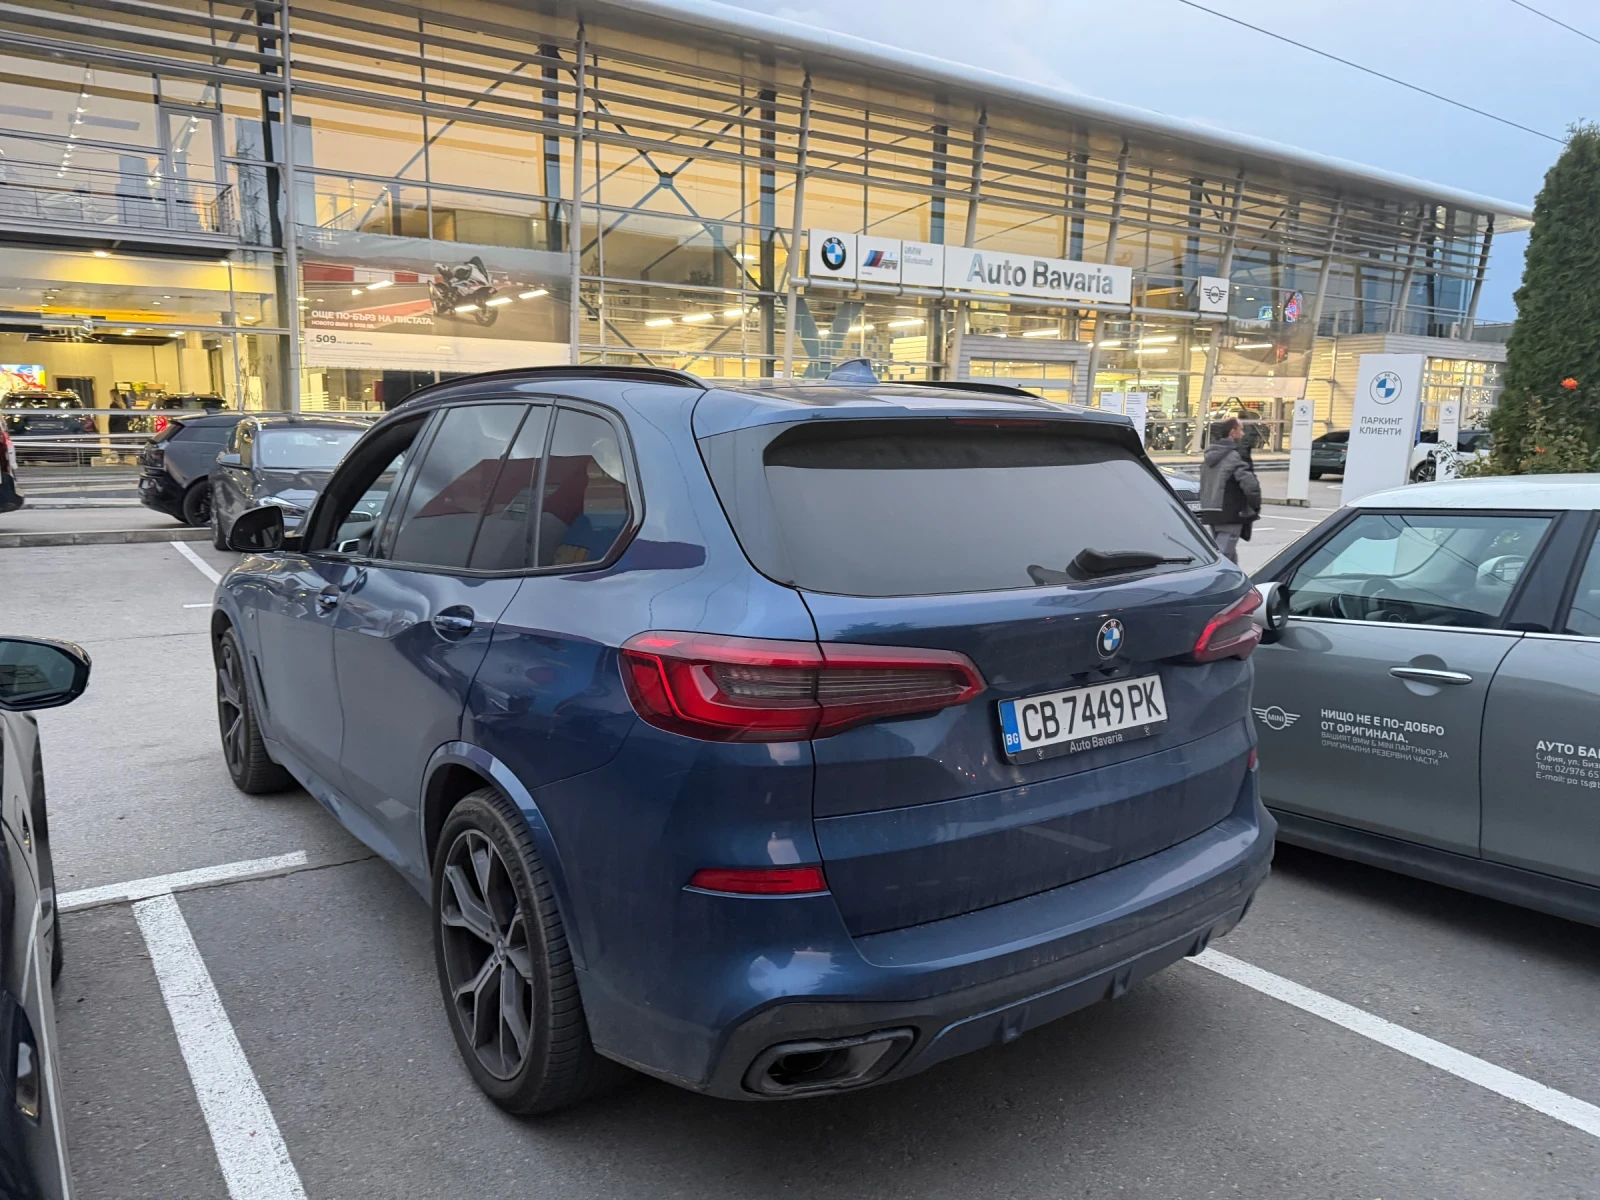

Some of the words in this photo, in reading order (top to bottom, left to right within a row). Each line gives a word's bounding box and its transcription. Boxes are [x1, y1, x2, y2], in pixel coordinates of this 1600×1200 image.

[967, 253, 1027, 288] Auto
[1032, 260, 1113, 295] Bavaria
[311, 310, 334, 319] ОЩЕ
[336, 312, 376, 321] ПО-БЪРЗ
[378, 314, 392, 322] НА
[316, 334, 336, 344] 509
[1361, 416, 1403, 425] ПАРКИНГ
[1359, 426, 1402, 435] КЛИЕНТИ
[1268, 713, 1284, 722] MINI
[1321, 709, 1354, 722] НИЩО
[1356, 714, 1371, 725] НЕ
[1373, 716, 1381, 726] Е
[1383, 718, 1445, 736] ПО-ДОБРО
[1006, 732, 1019, 746] BG
[1321, 721, 1335, 731] ОТ
[1337, 723, 1409, 744] ОРИГИНАЛА.
[1070, 740, 1091, 753] Auto
[1092, 732, 1123, 749] Bavaria
[1321, 731, 1351, 742] ВАШИЯТ
[1352, 736, 1370, 746] BMW
[1378, 741, 1394, 749] MINI
[1395, 743, 1436, 756] ПАРТНЬОР
[1438, 750, 1449, 759] ЗА
[1536, 740, 1574, 755] АУТО
[1578, 746, 1600, 759] БА
[1321, 739, 1371, 753] ОРИГИНАЛНИ
[1372, 748, 1412, 760] РЕЗЕРВНИ
[1413, 754, 1439, 765] ЧАСТИ
[1555, 765, 1586, 777] 02/976
[1582, 759, 1600, 769] Биз
